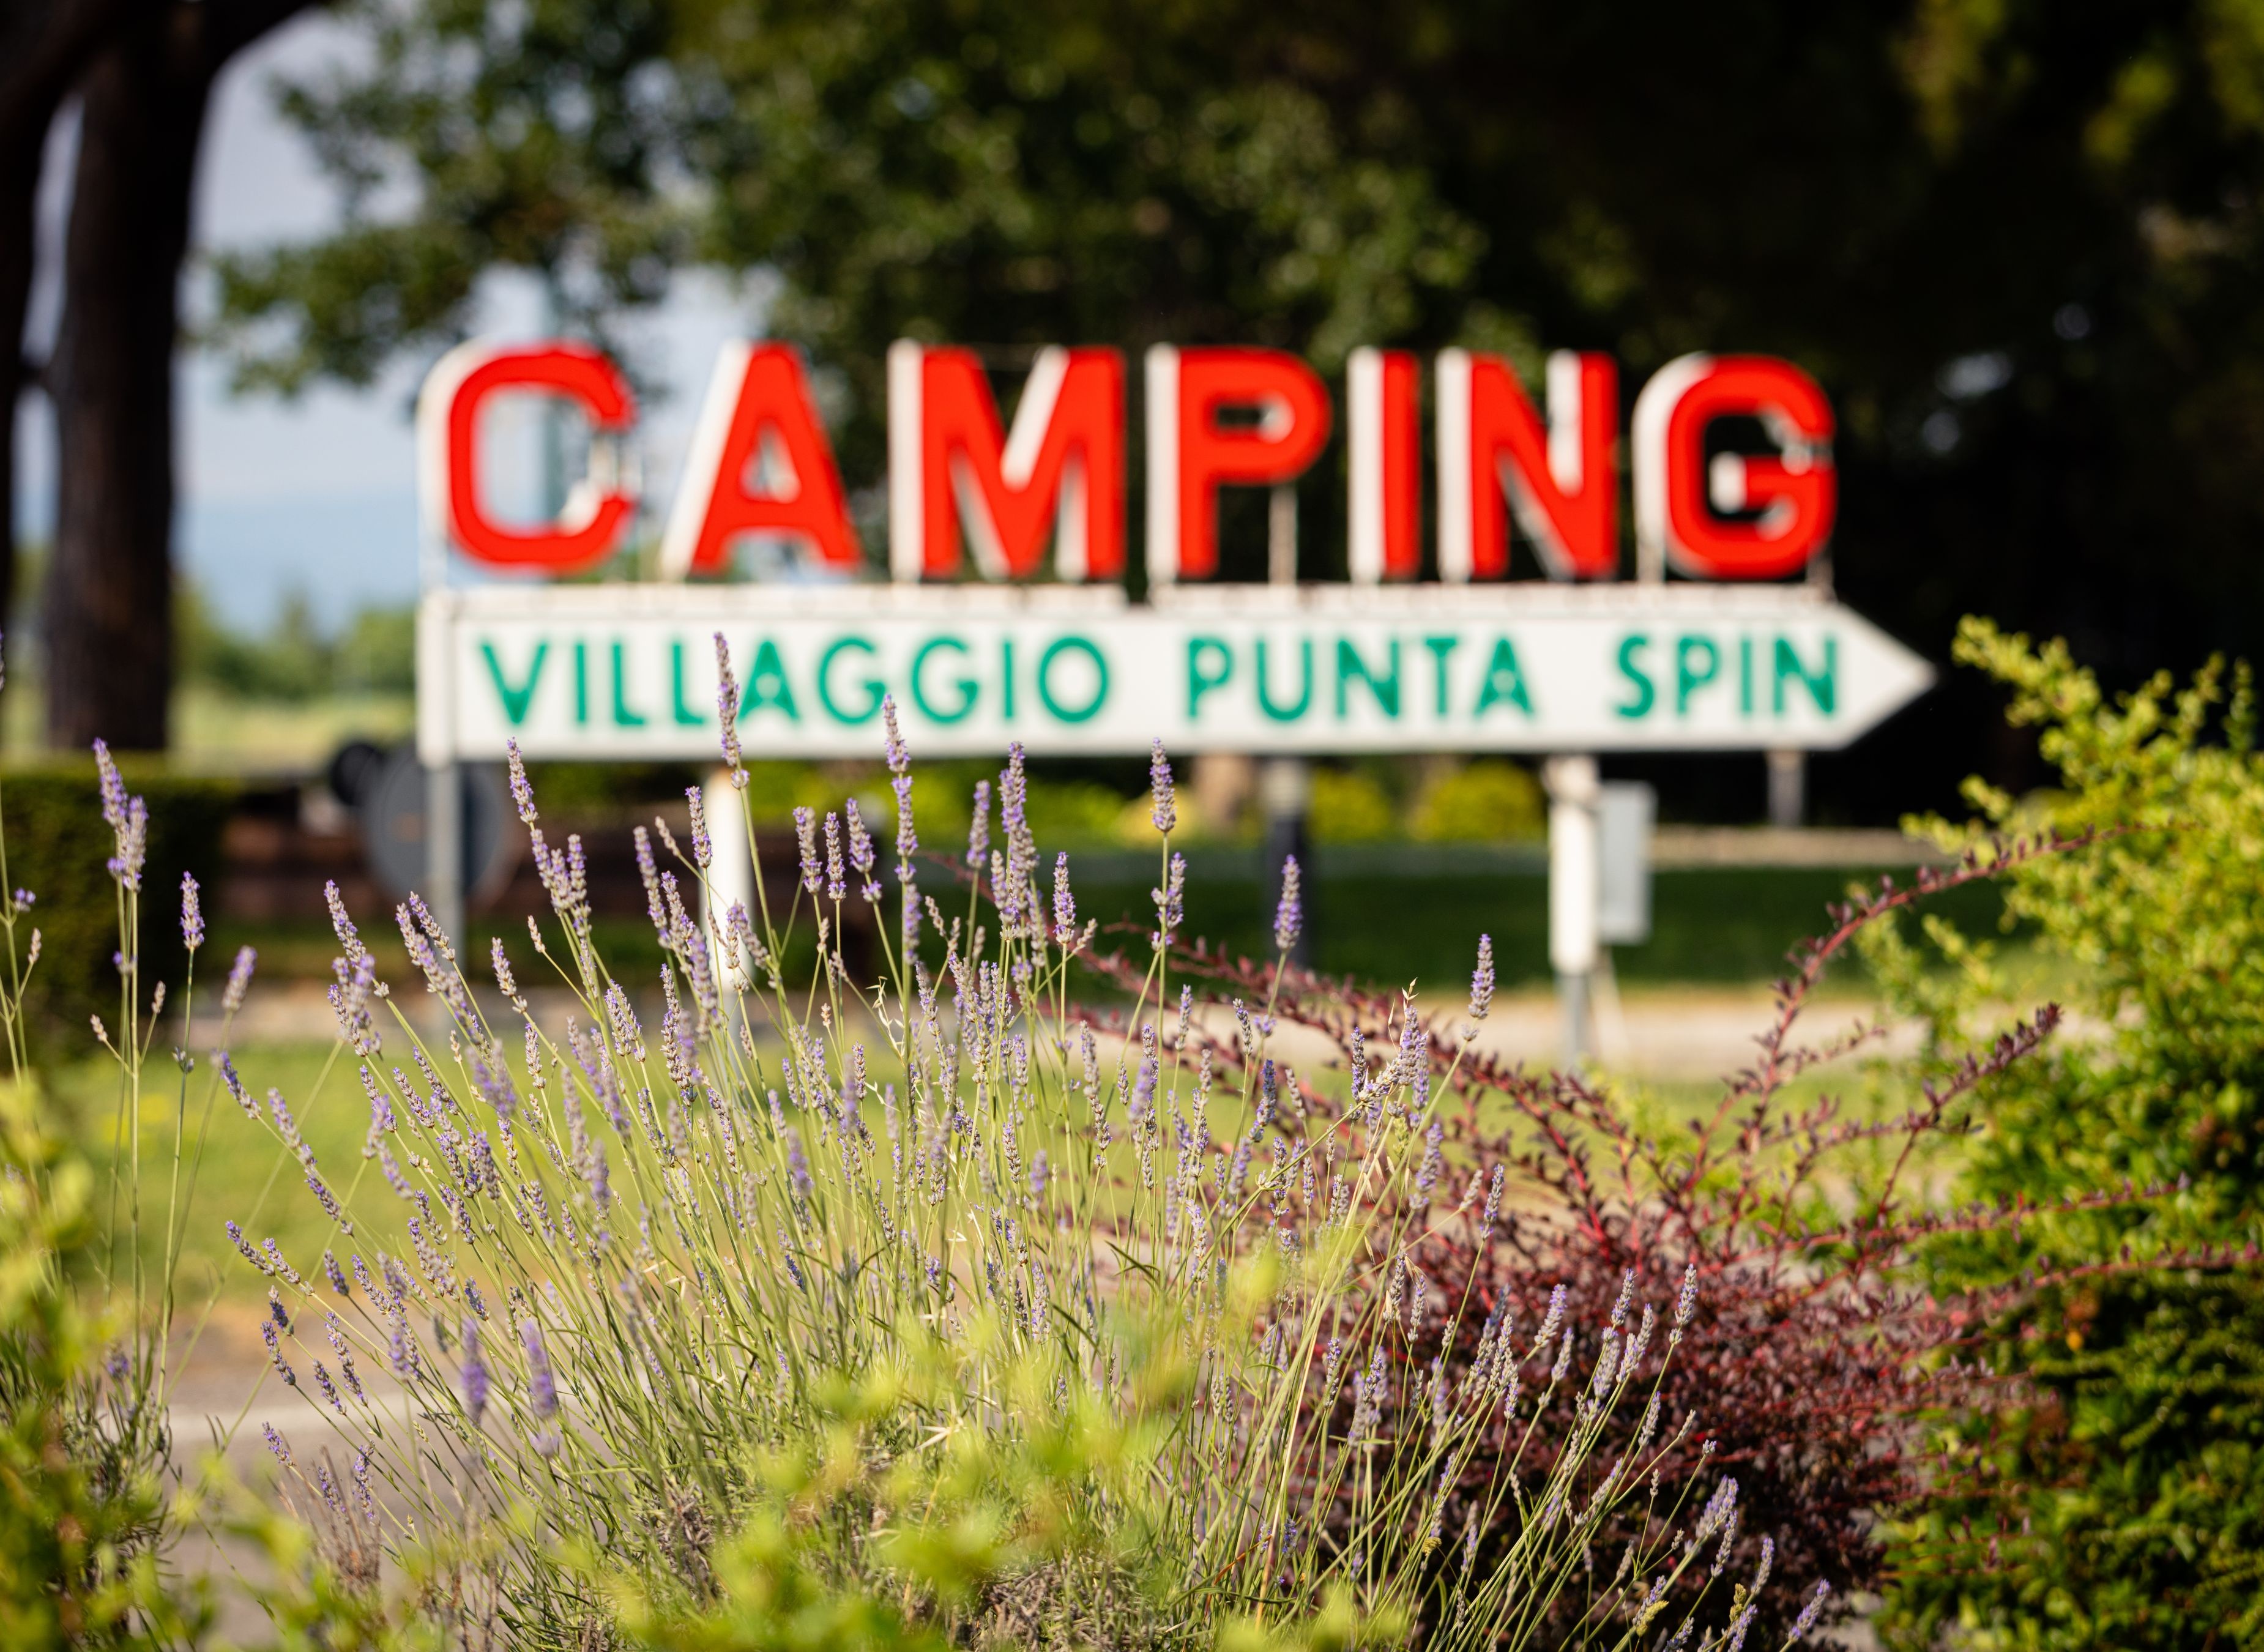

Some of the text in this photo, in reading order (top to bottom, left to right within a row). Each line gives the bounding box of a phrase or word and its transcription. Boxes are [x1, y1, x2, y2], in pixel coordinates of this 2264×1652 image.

[442, 341, 1836, 578] CAMPING
[480, 633, 1838, 729] VILLAGGIO PUNTA SPIN
